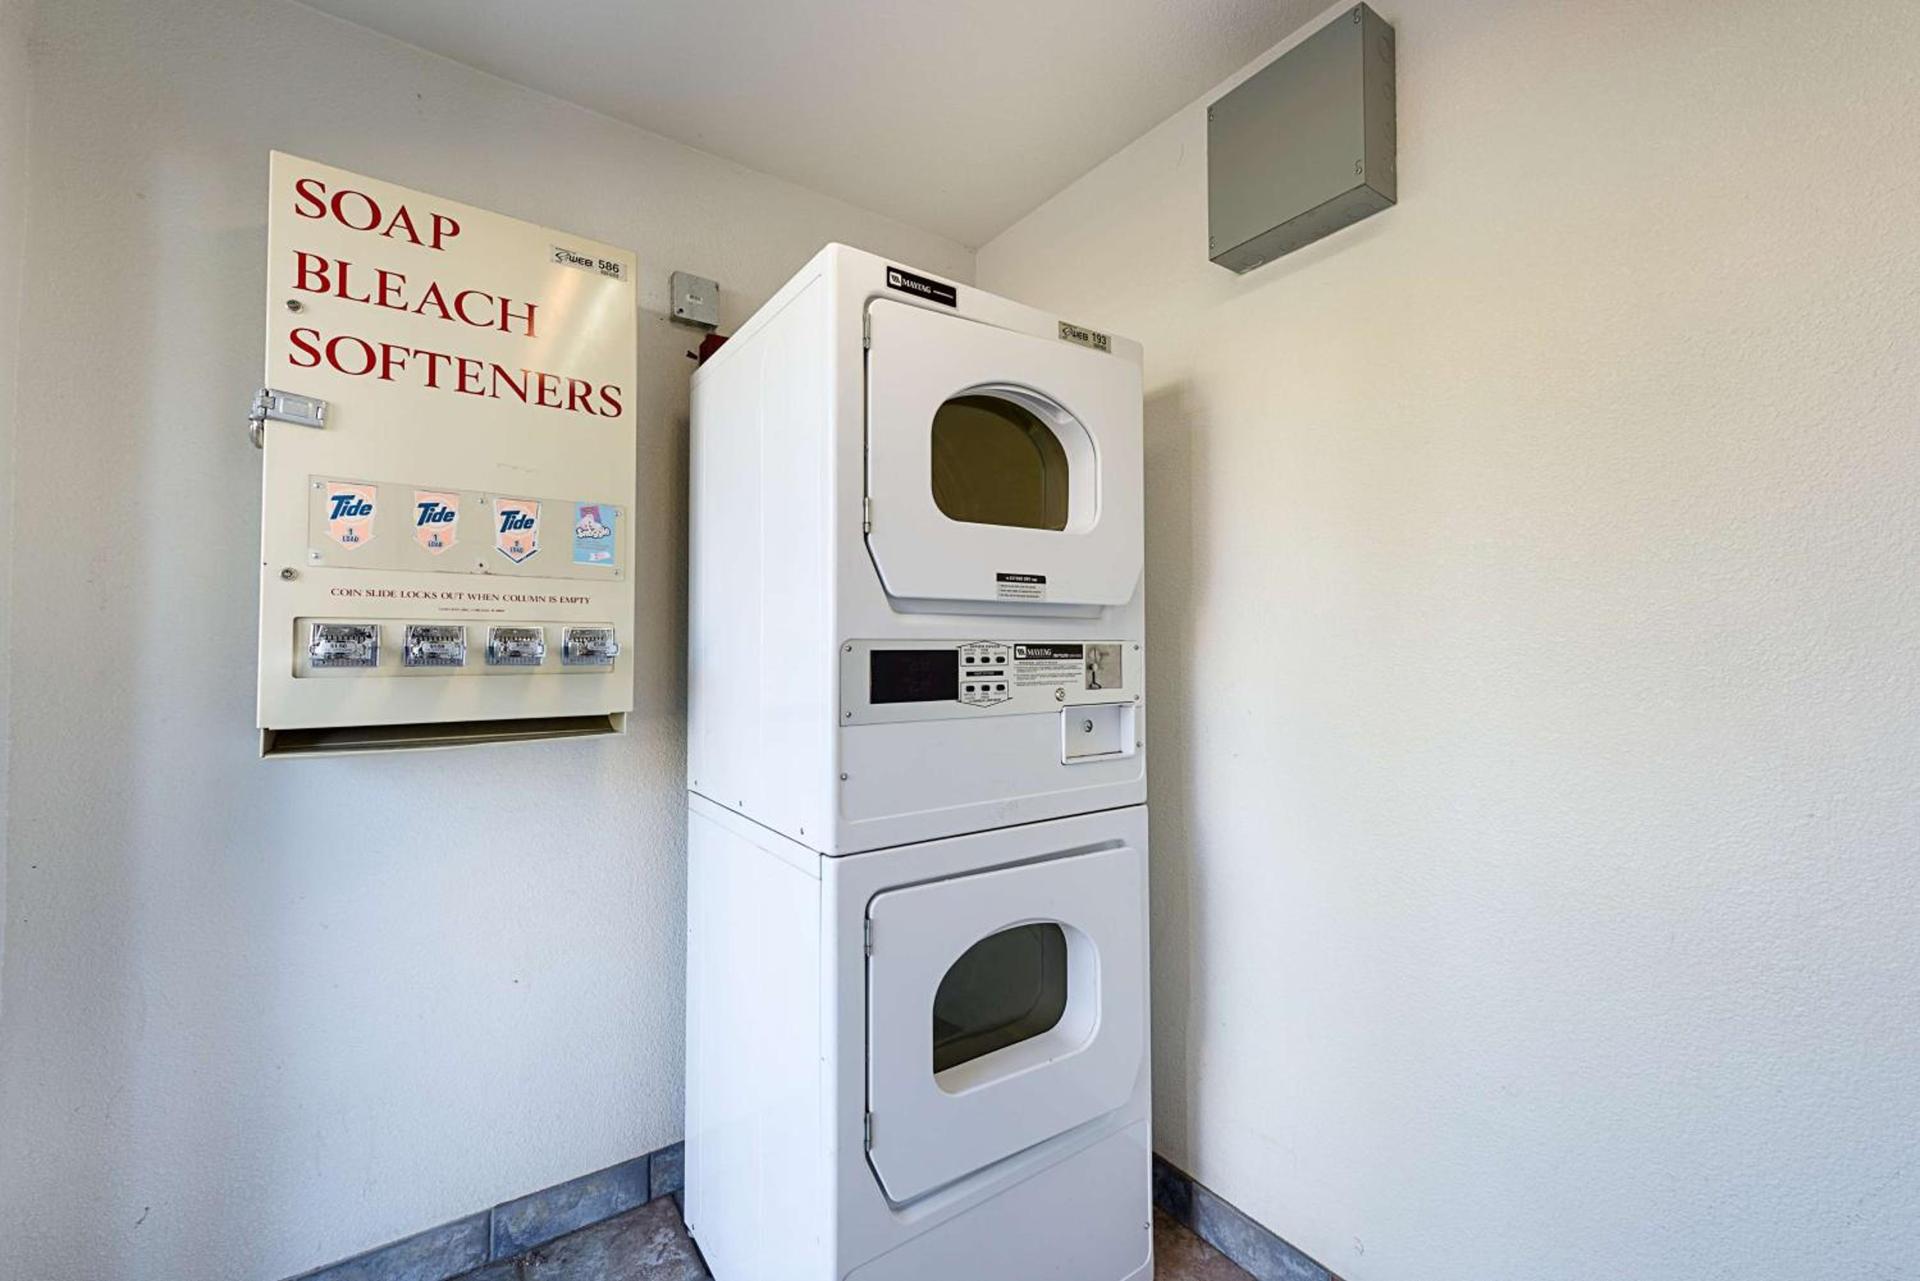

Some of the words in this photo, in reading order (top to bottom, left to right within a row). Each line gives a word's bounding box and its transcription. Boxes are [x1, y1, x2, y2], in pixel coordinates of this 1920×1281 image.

[294, 178, 460, 251] SOAP
[598, 259, 620, 273] 586
[293, 250, 539, 338] BLEACH
[901, 278, 932, 294] MAYTAG
[1092, 331, 1107, 345] 193
[288, 328, 623, 419] SOFTENERS
[330, 495, 373, 520] Tide
[417, 502, 456, 526] Tide
[500, 510, 535, 533] Tide
[330, 588, 362, 597] COIN
[365, 589, 396, 598] SLIDE
[400, 590, 438, 599] LOCKS
[440, 591, 465, 600] OUT
[467, 592, 500, 601] WHEN
[502, 594, 546, 602] COLUMN
[548, 595, 559, 603] IS
[559, 596, 591, 604] EMPTY
